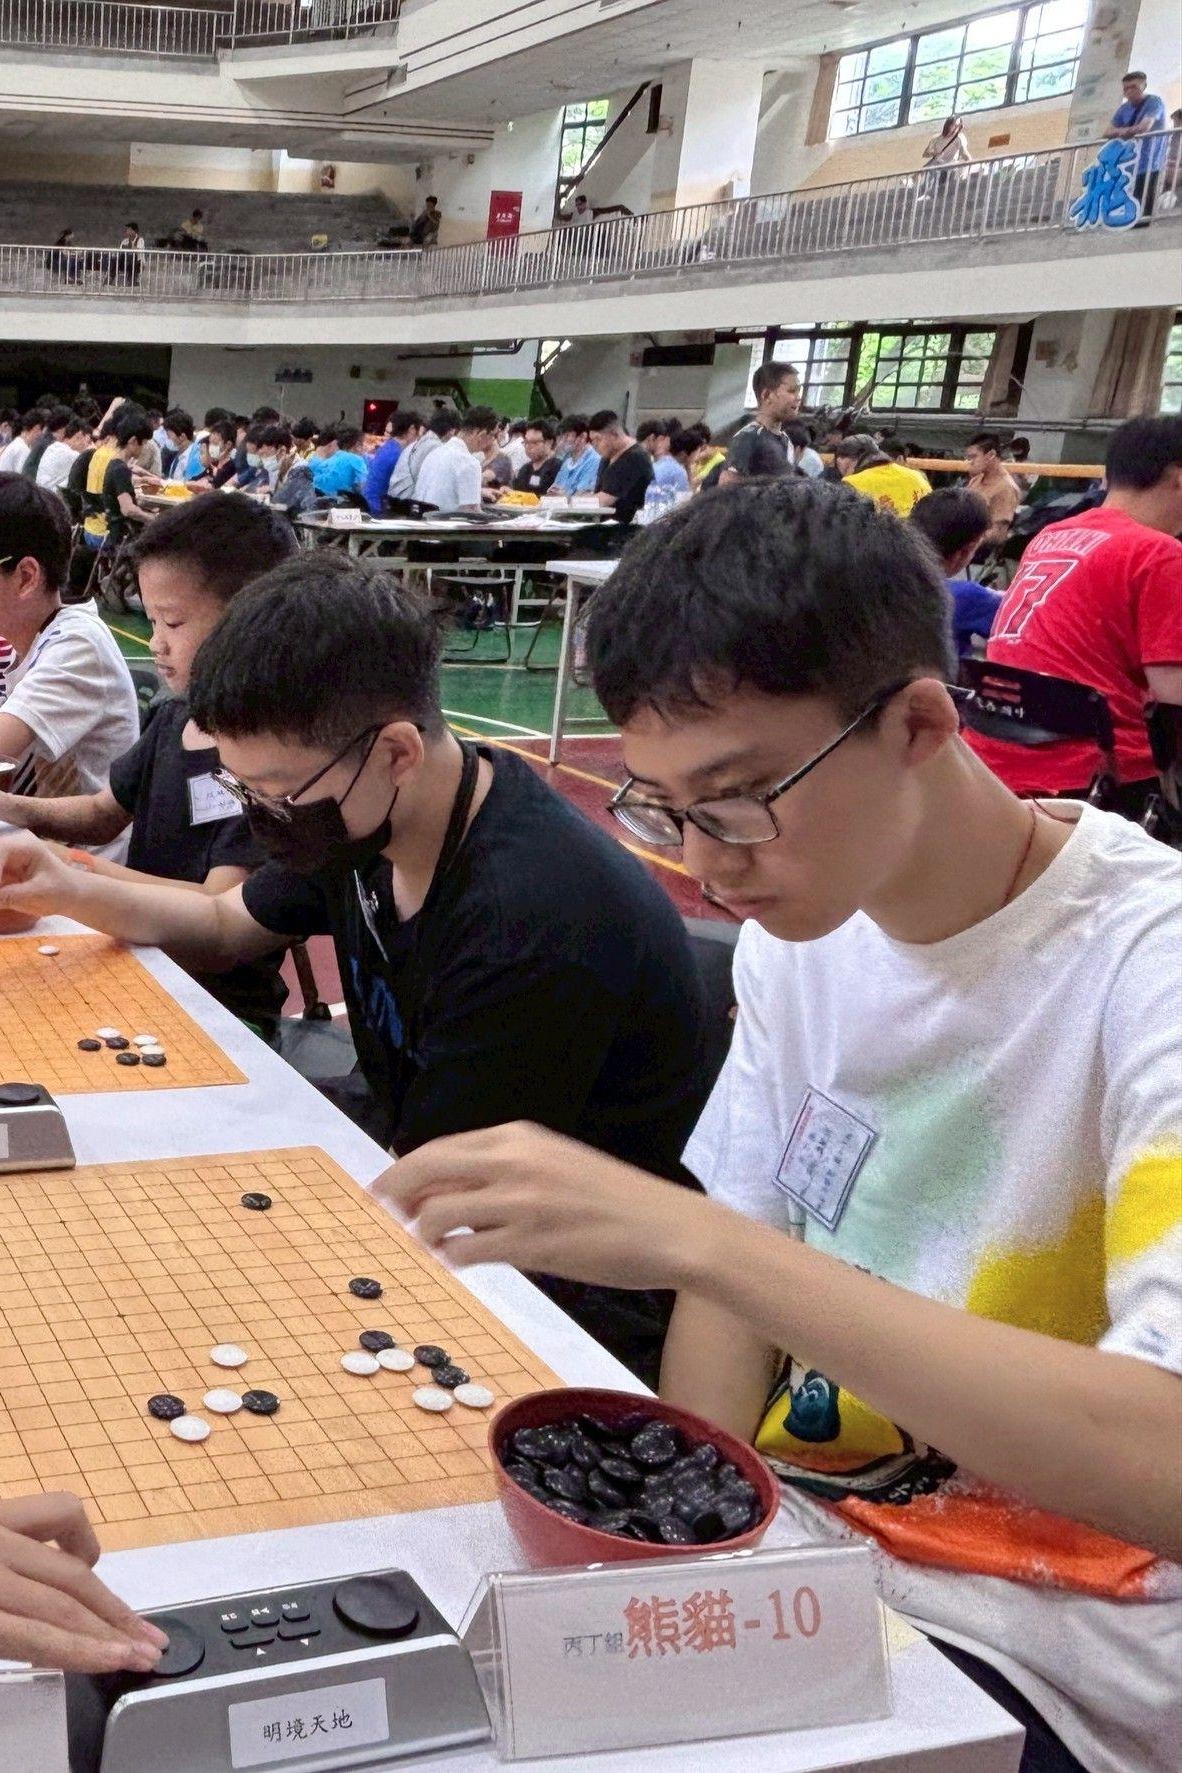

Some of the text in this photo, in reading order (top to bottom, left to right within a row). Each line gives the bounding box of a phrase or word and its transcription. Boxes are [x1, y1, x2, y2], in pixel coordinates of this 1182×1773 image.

[623, 1586, 821, 1659] 熊貓-10
[263, 1709, 353, 1743] 明境天地
